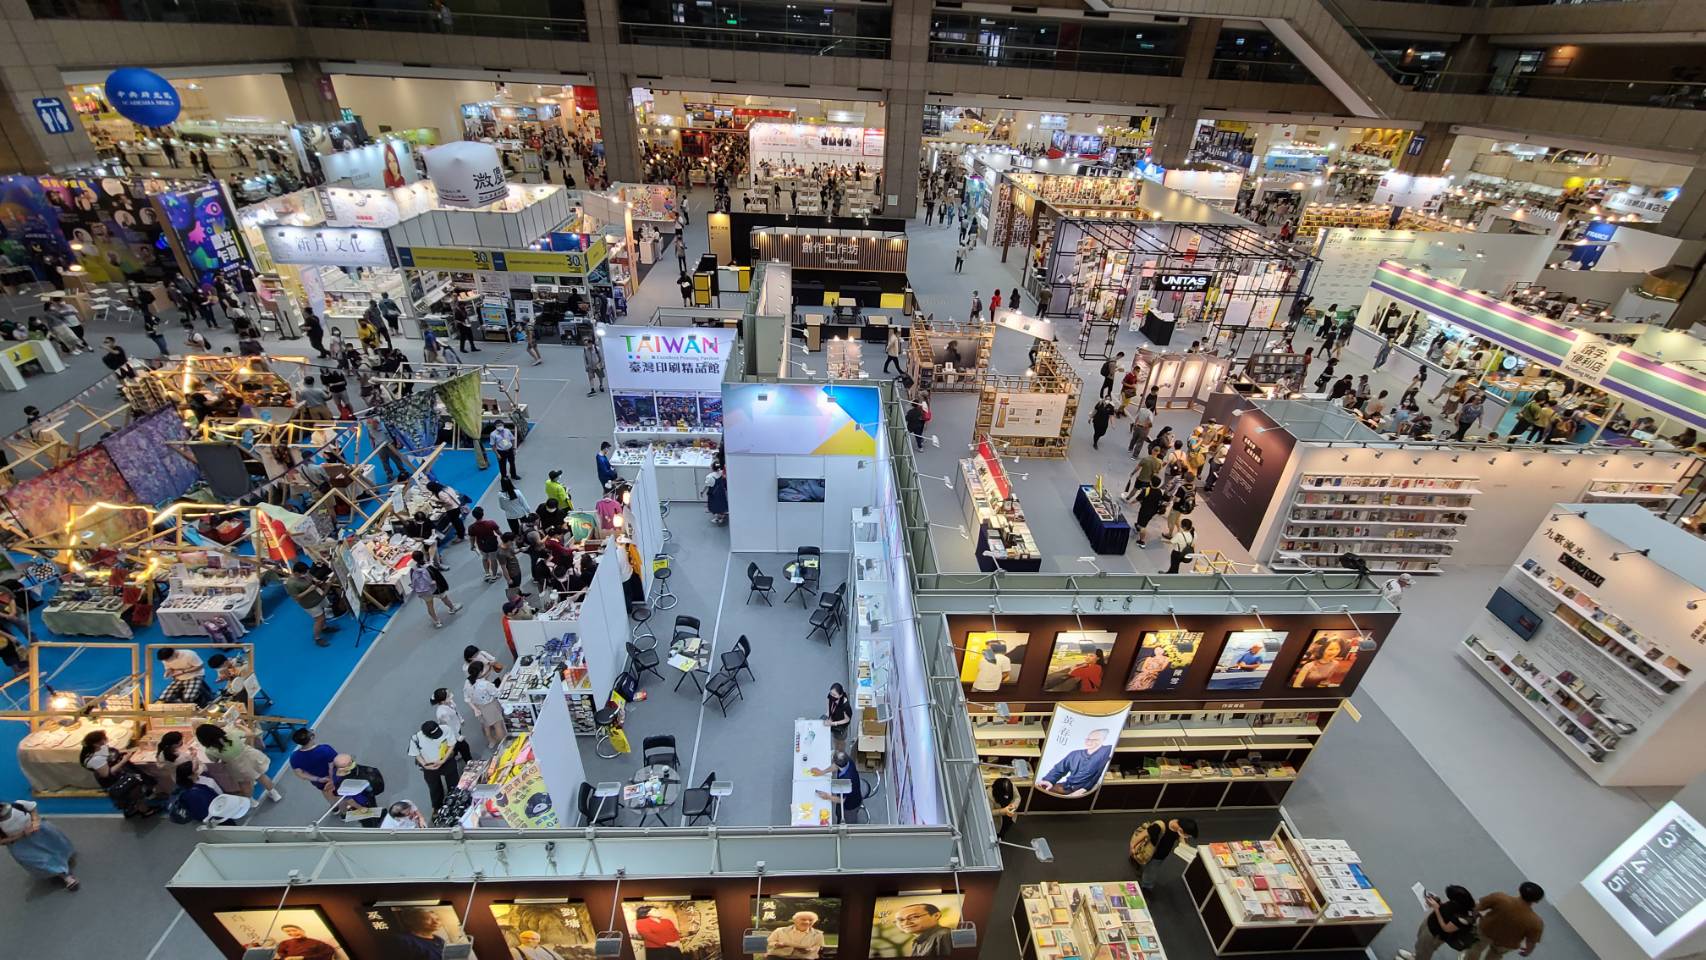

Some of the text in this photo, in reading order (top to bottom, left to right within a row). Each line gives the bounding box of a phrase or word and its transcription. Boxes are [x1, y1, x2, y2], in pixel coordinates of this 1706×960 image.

[1586, 230, 1609, 240] FRANCE
[801, 241, 859, 256] 創作工作坊
[1161, 275, 1207, 286] UNITAS
[620, 334, 719, 354] TAIWAN
[628, 361, 720, 374] 臺灣印刷精品館
[1570, 353, 1605, 372] 便利店
[1658, 830, 1678, 848] 3
[1630, 860, 1648, 874] 4
[1608, 874, 1624, 893] 5
